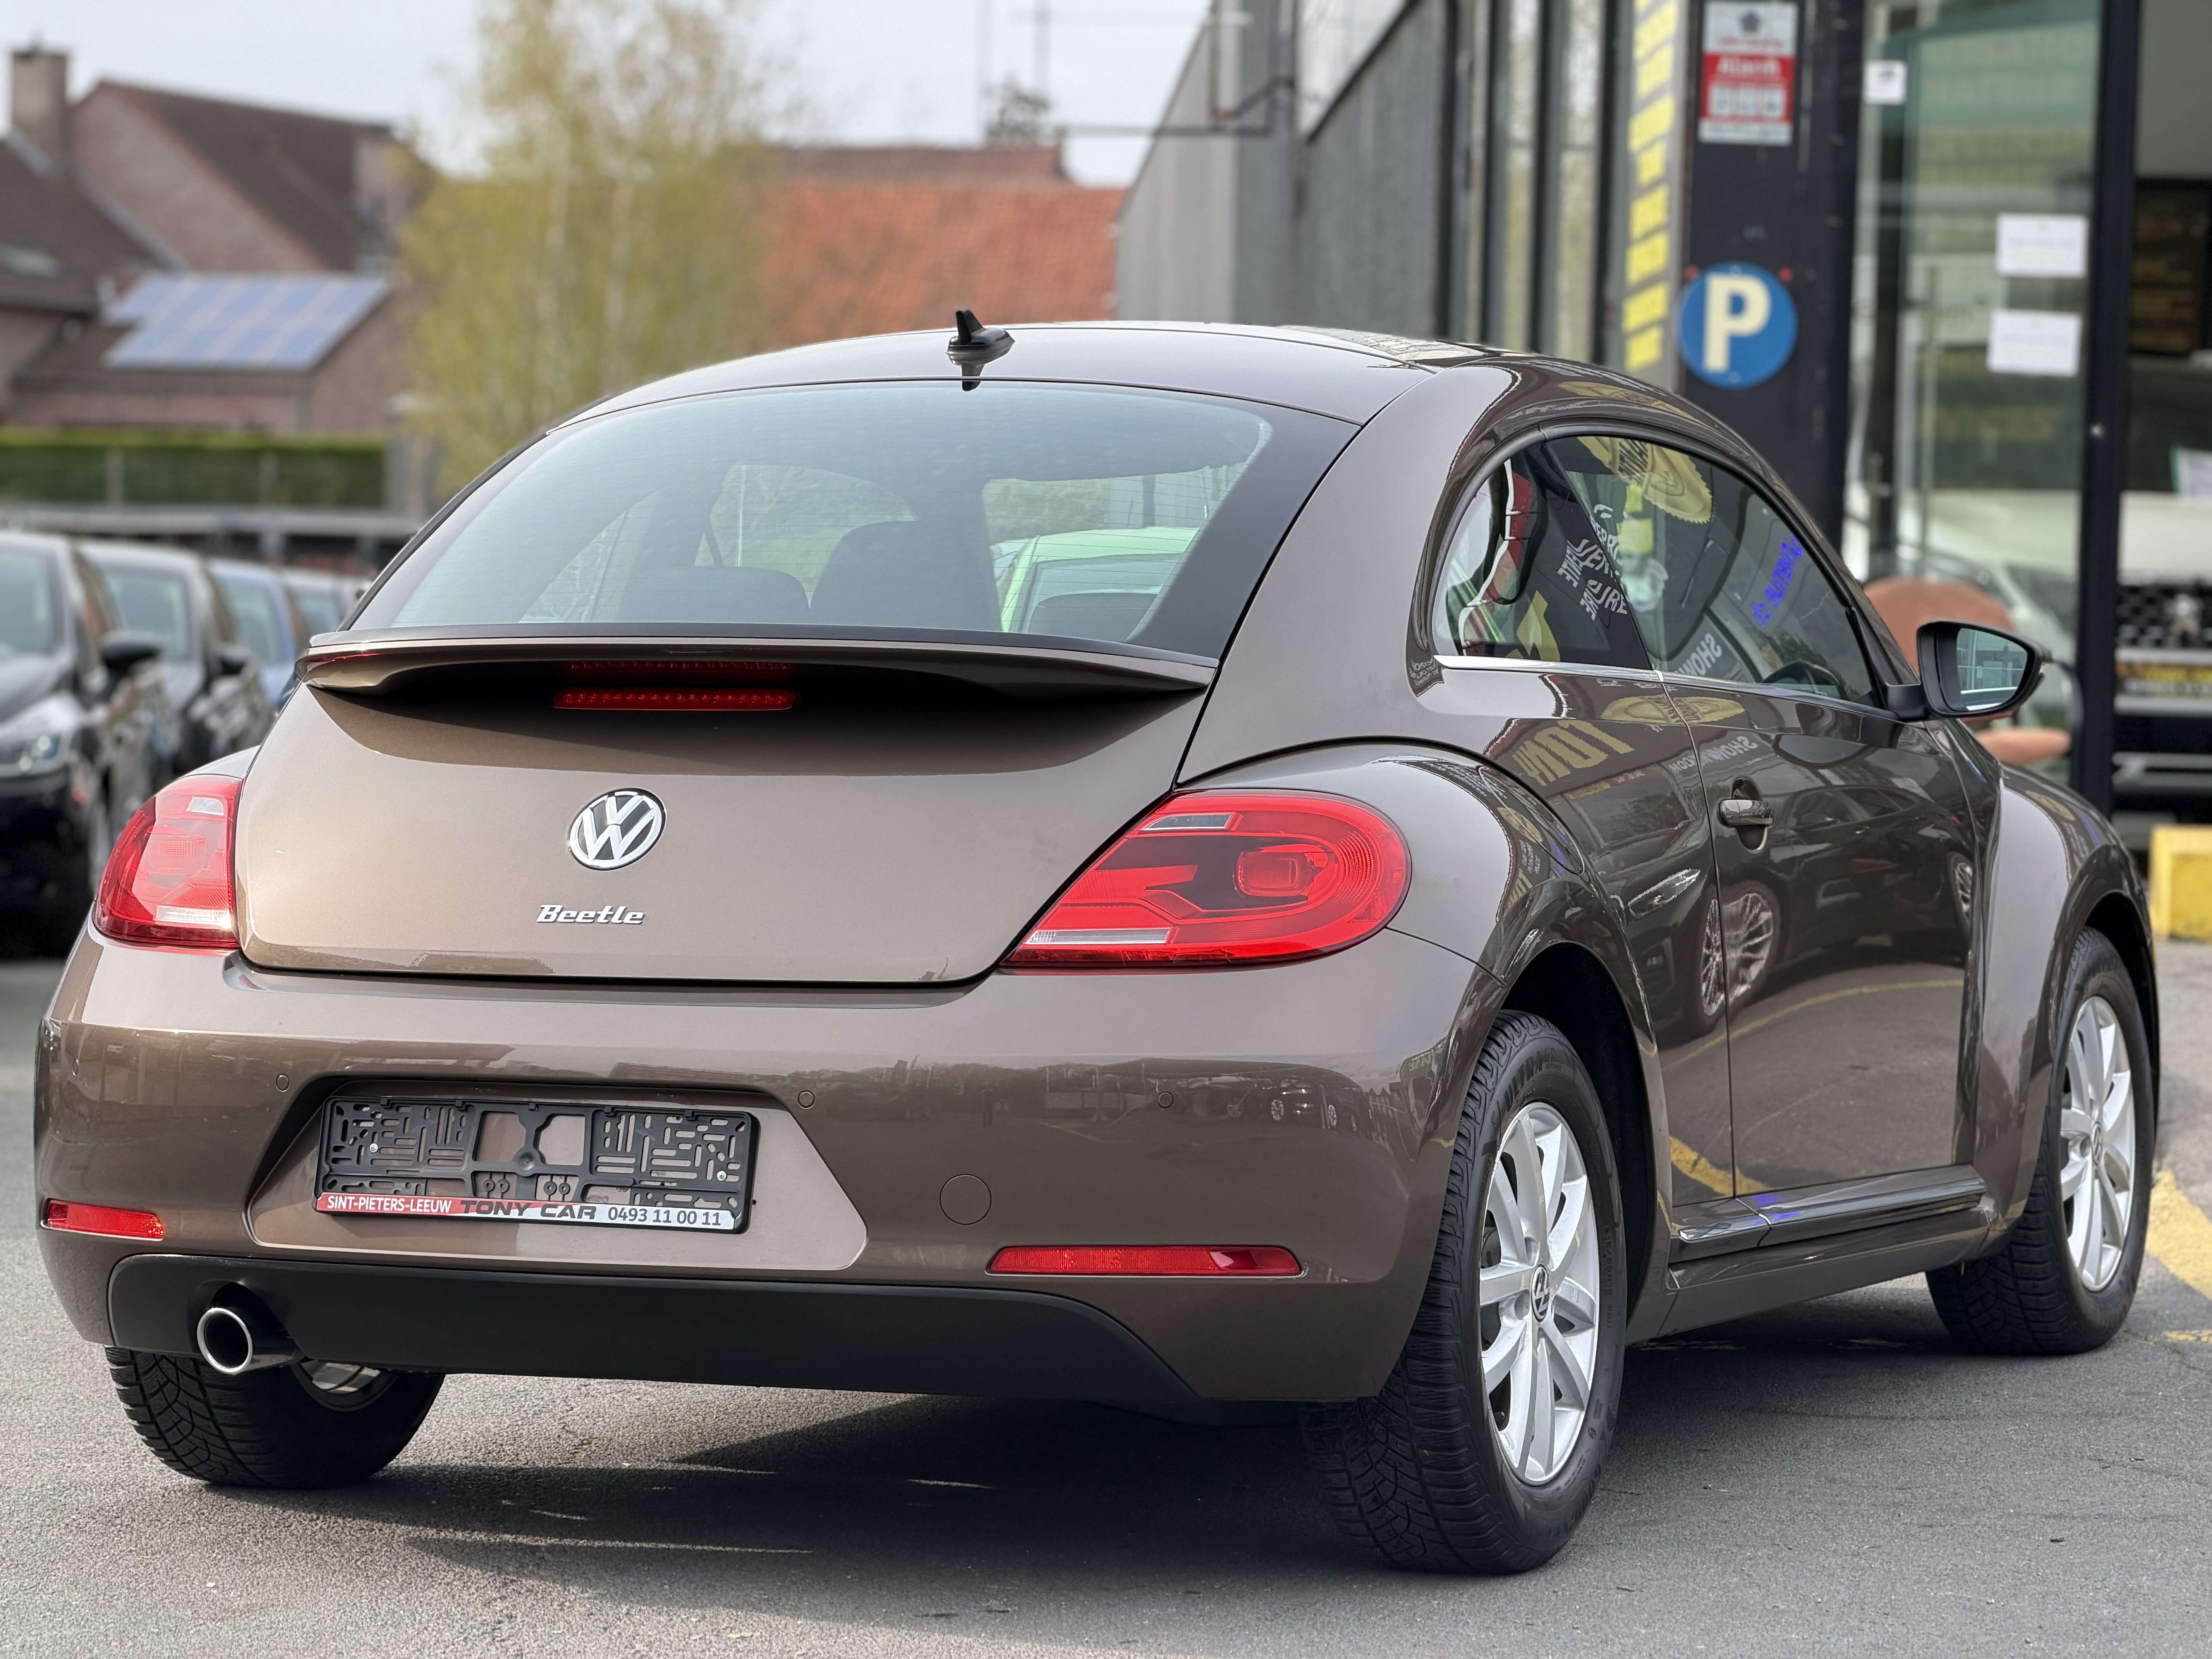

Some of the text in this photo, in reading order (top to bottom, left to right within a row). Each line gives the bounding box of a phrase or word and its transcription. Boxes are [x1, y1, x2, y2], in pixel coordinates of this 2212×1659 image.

[1704, 272, 1772, 373] P
[536, 904, 645, 924] Beetle
[327, 1195, 721, 1226] SINT-PIETERS-LEEUW TONY CAR 0493 11 00 11
